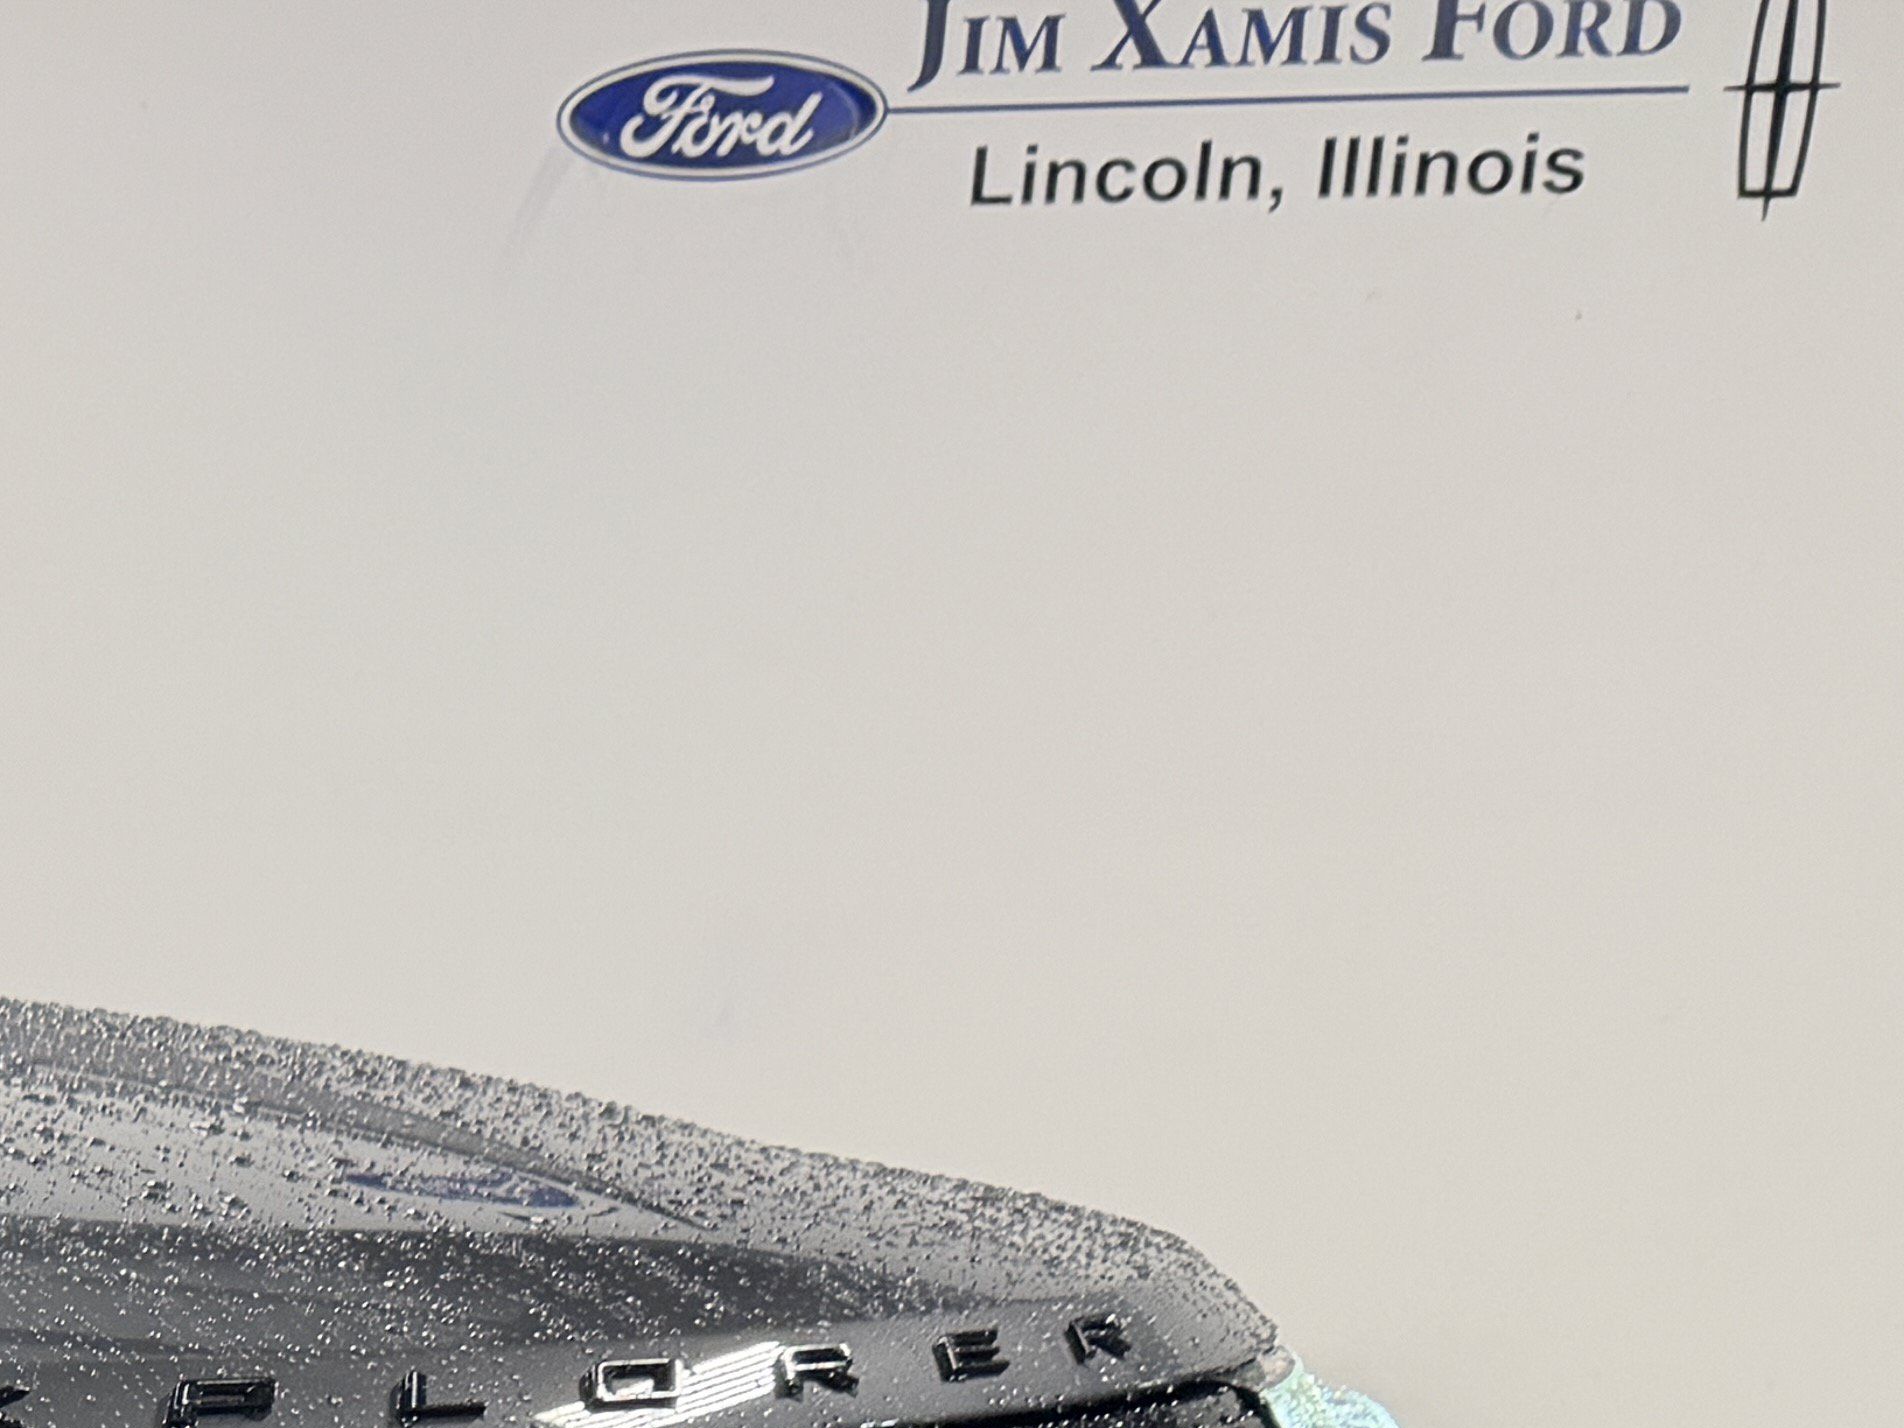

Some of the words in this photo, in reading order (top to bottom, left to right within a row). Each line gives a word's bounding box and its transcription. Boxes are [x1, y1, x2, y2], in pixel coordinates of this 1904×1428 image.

[908, 0, 1065, 93] JIM
[1091, 0, 1391, 71] XAMIS
[1422, 0, 1682, 63] FORD
[620, 74, 823, 158] Ford
[970, 139, 1284, 210] Lincoln,
[1317, 132, 1586, 199] Illinois
